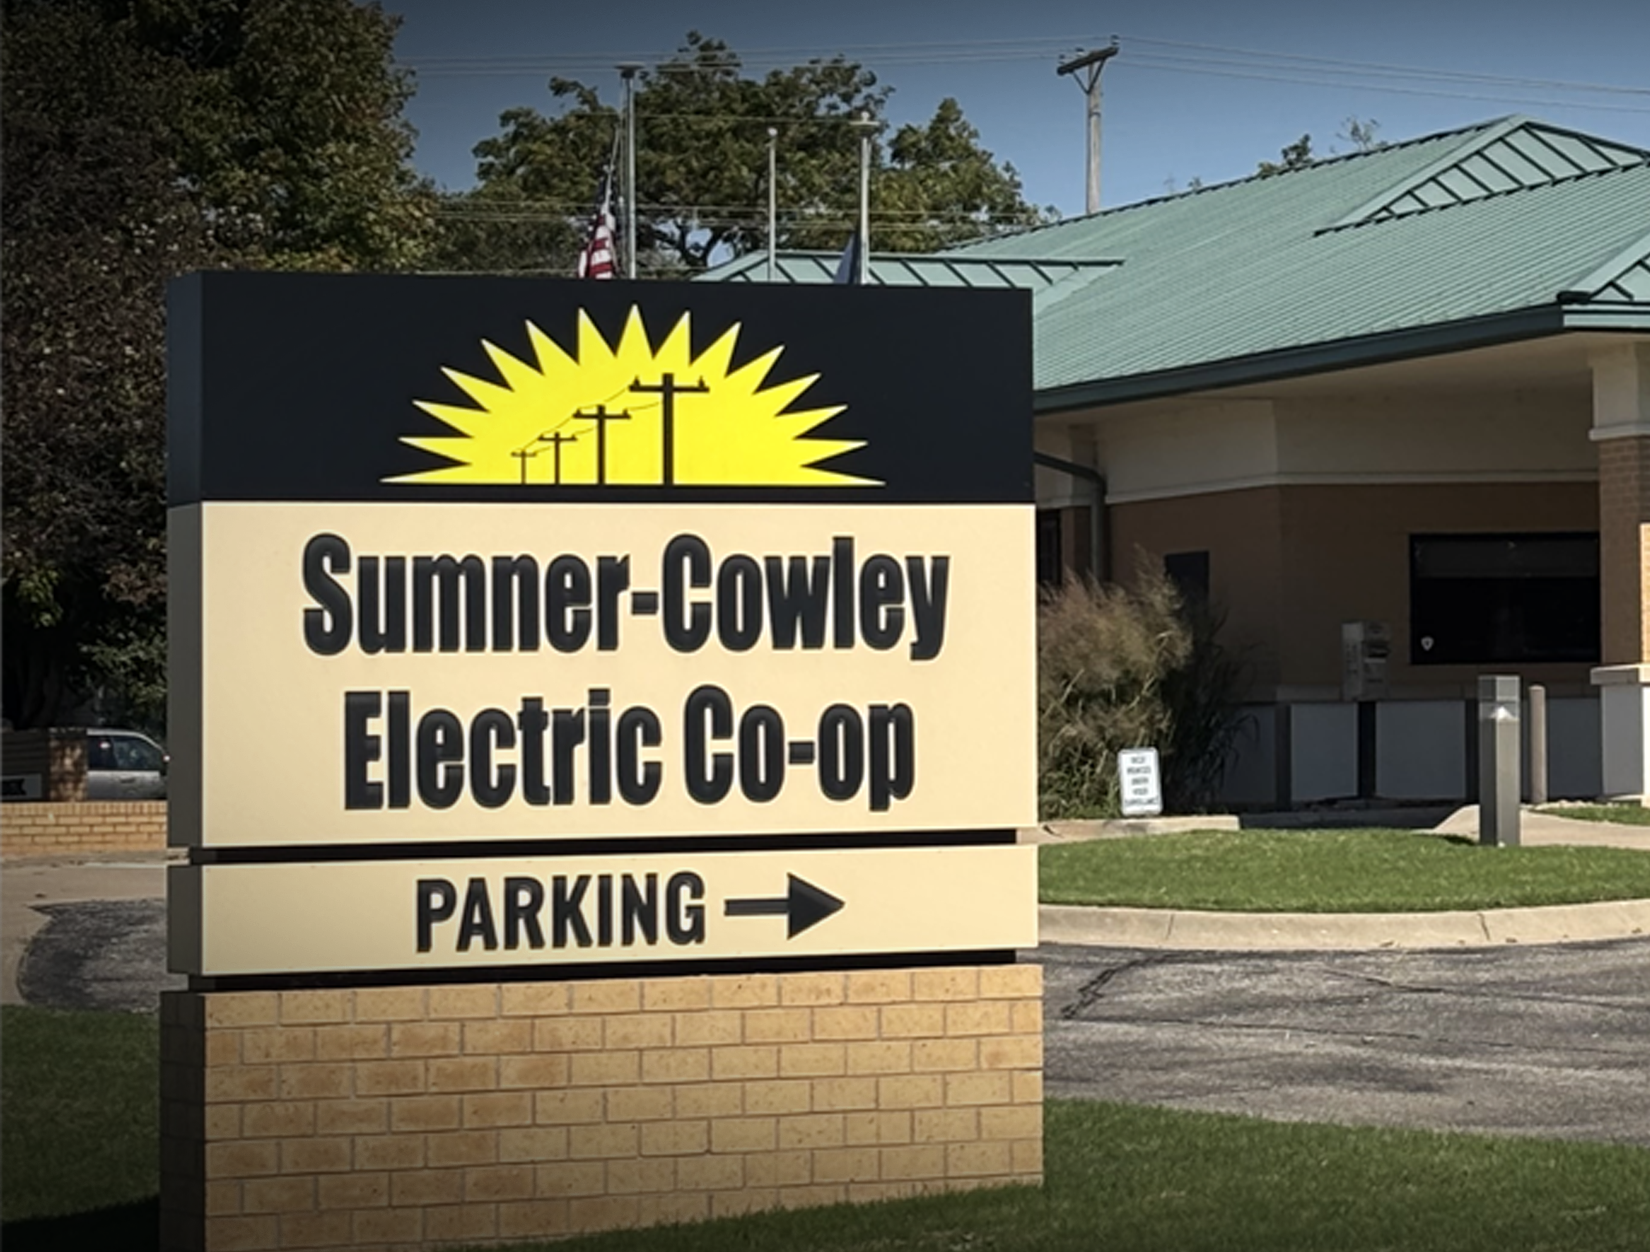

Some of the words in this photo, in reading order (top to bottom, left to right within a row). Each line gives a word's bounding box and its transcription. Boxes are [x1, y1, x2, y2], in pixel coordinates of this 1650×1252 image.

[303, 533, 950, 661] Sumner-Cowley
[344, 688, 662, 810] Electric
[684, 685, 915, 812] Co-op
[416, 871, 706, 953] PARKING
